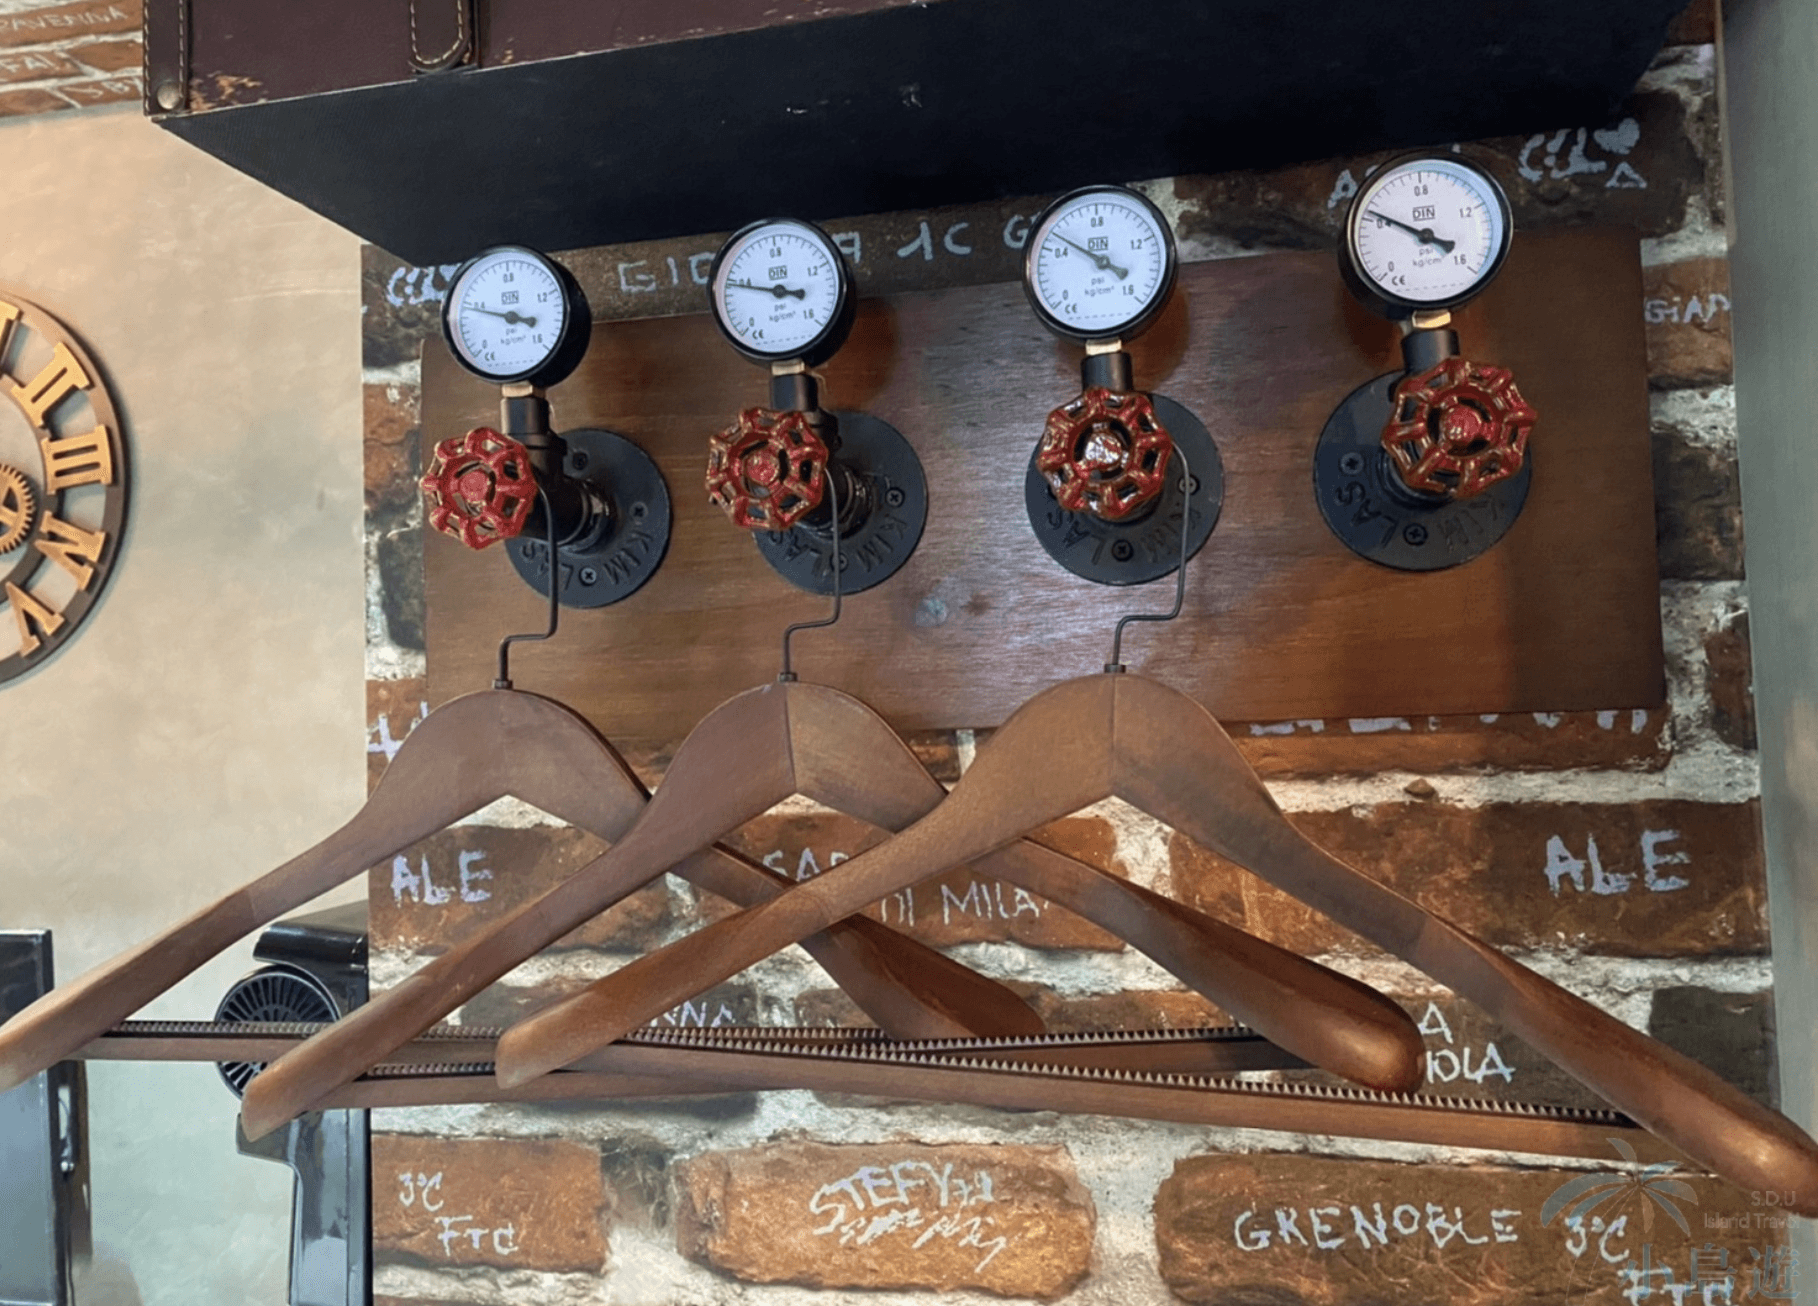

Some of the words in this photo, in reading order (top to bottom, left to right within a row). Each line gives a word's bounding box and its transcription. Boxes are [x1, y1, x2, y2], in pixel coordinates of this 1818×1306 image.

[1414, 184, 1429, 197] 0.8
[1413, 205, 1435, 221] DIN
[1460, 207, 1472, 218] 1.2
[1087, 236, 1108, 251] DIN
[1130, 239, 1142, 250] 1.2
[768, 265, 787, 281] DIN
[501, 290, 519, 305] DIN
[41, 425, 112, 495] III
[1544, 829, 1691, 898] ALE
[391, 850, 494, 908] ALE
[941, 881, 1049, 925] MILA
